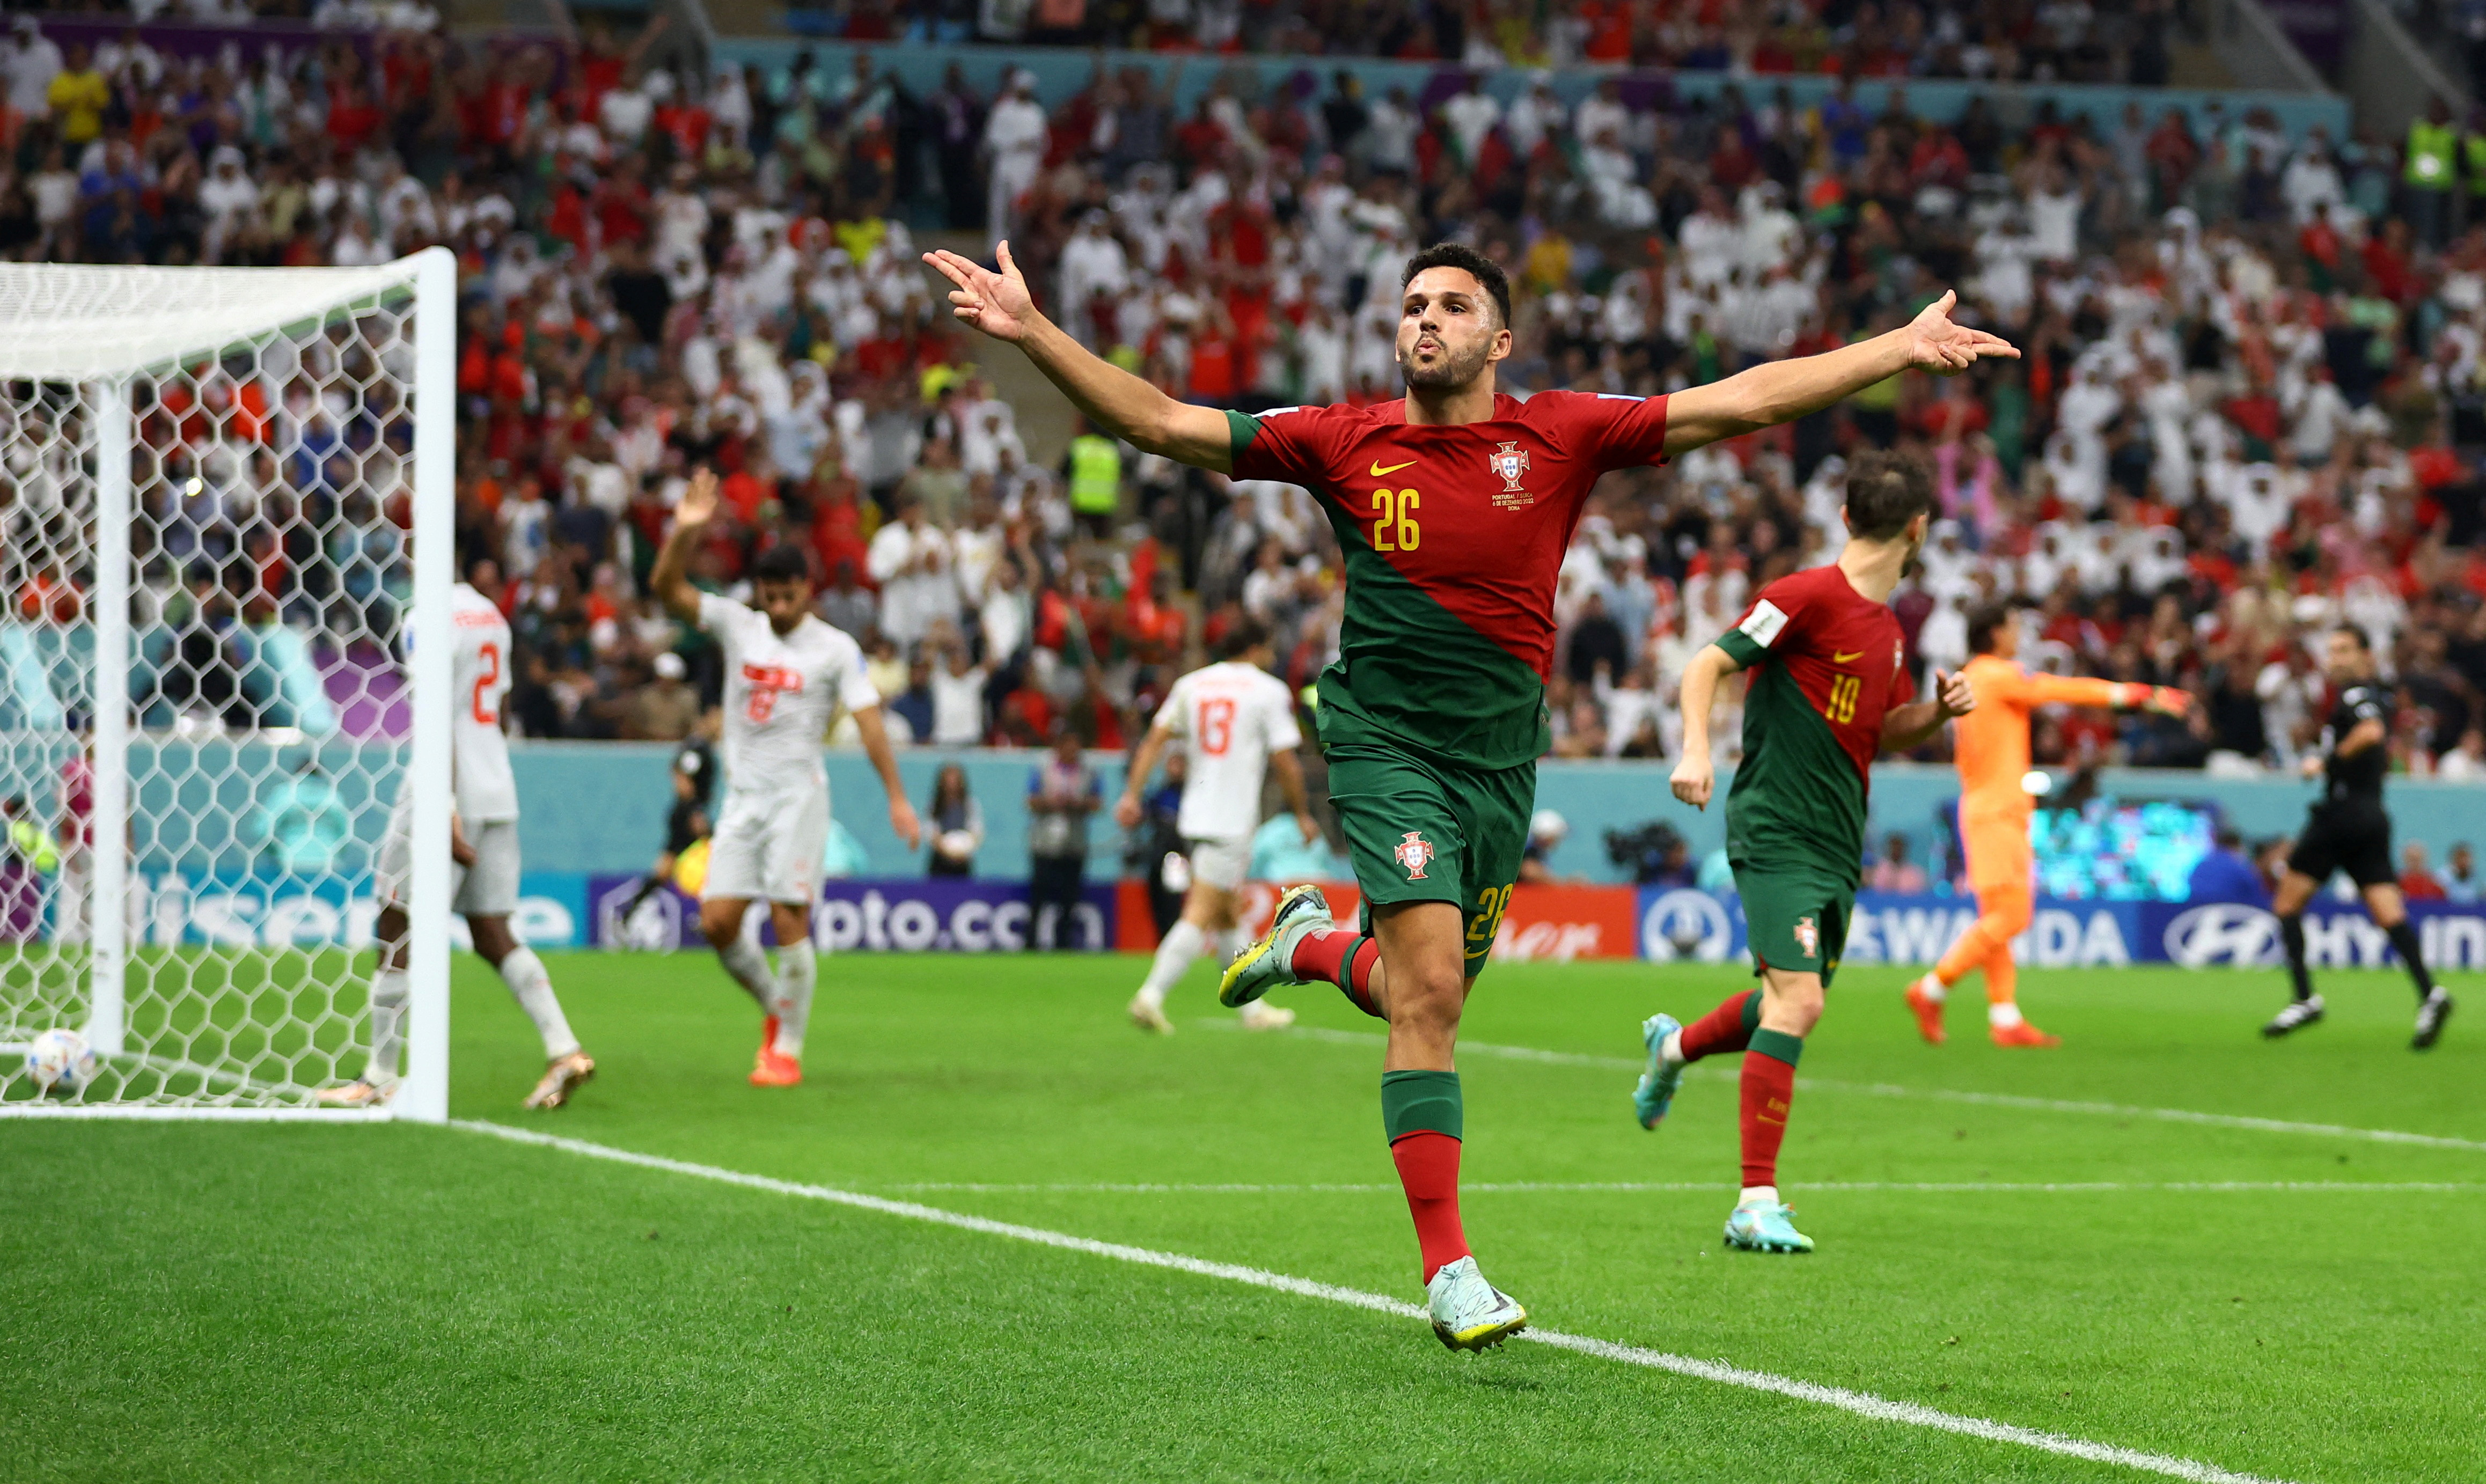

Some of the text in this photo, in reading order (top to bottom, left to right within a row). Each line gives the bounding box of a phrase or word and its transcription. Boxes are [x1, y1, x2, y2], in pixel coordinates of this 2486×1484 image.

[1373, 488, 1420, 551] 26
[472, 641, 499, 724] 2
[1825, 674, 1861, 724] 10
[1198, 697, 1236, 756] 13
[1466, 883, 1513, 941] 26
[1881, 907, 2132, 966] WADA
